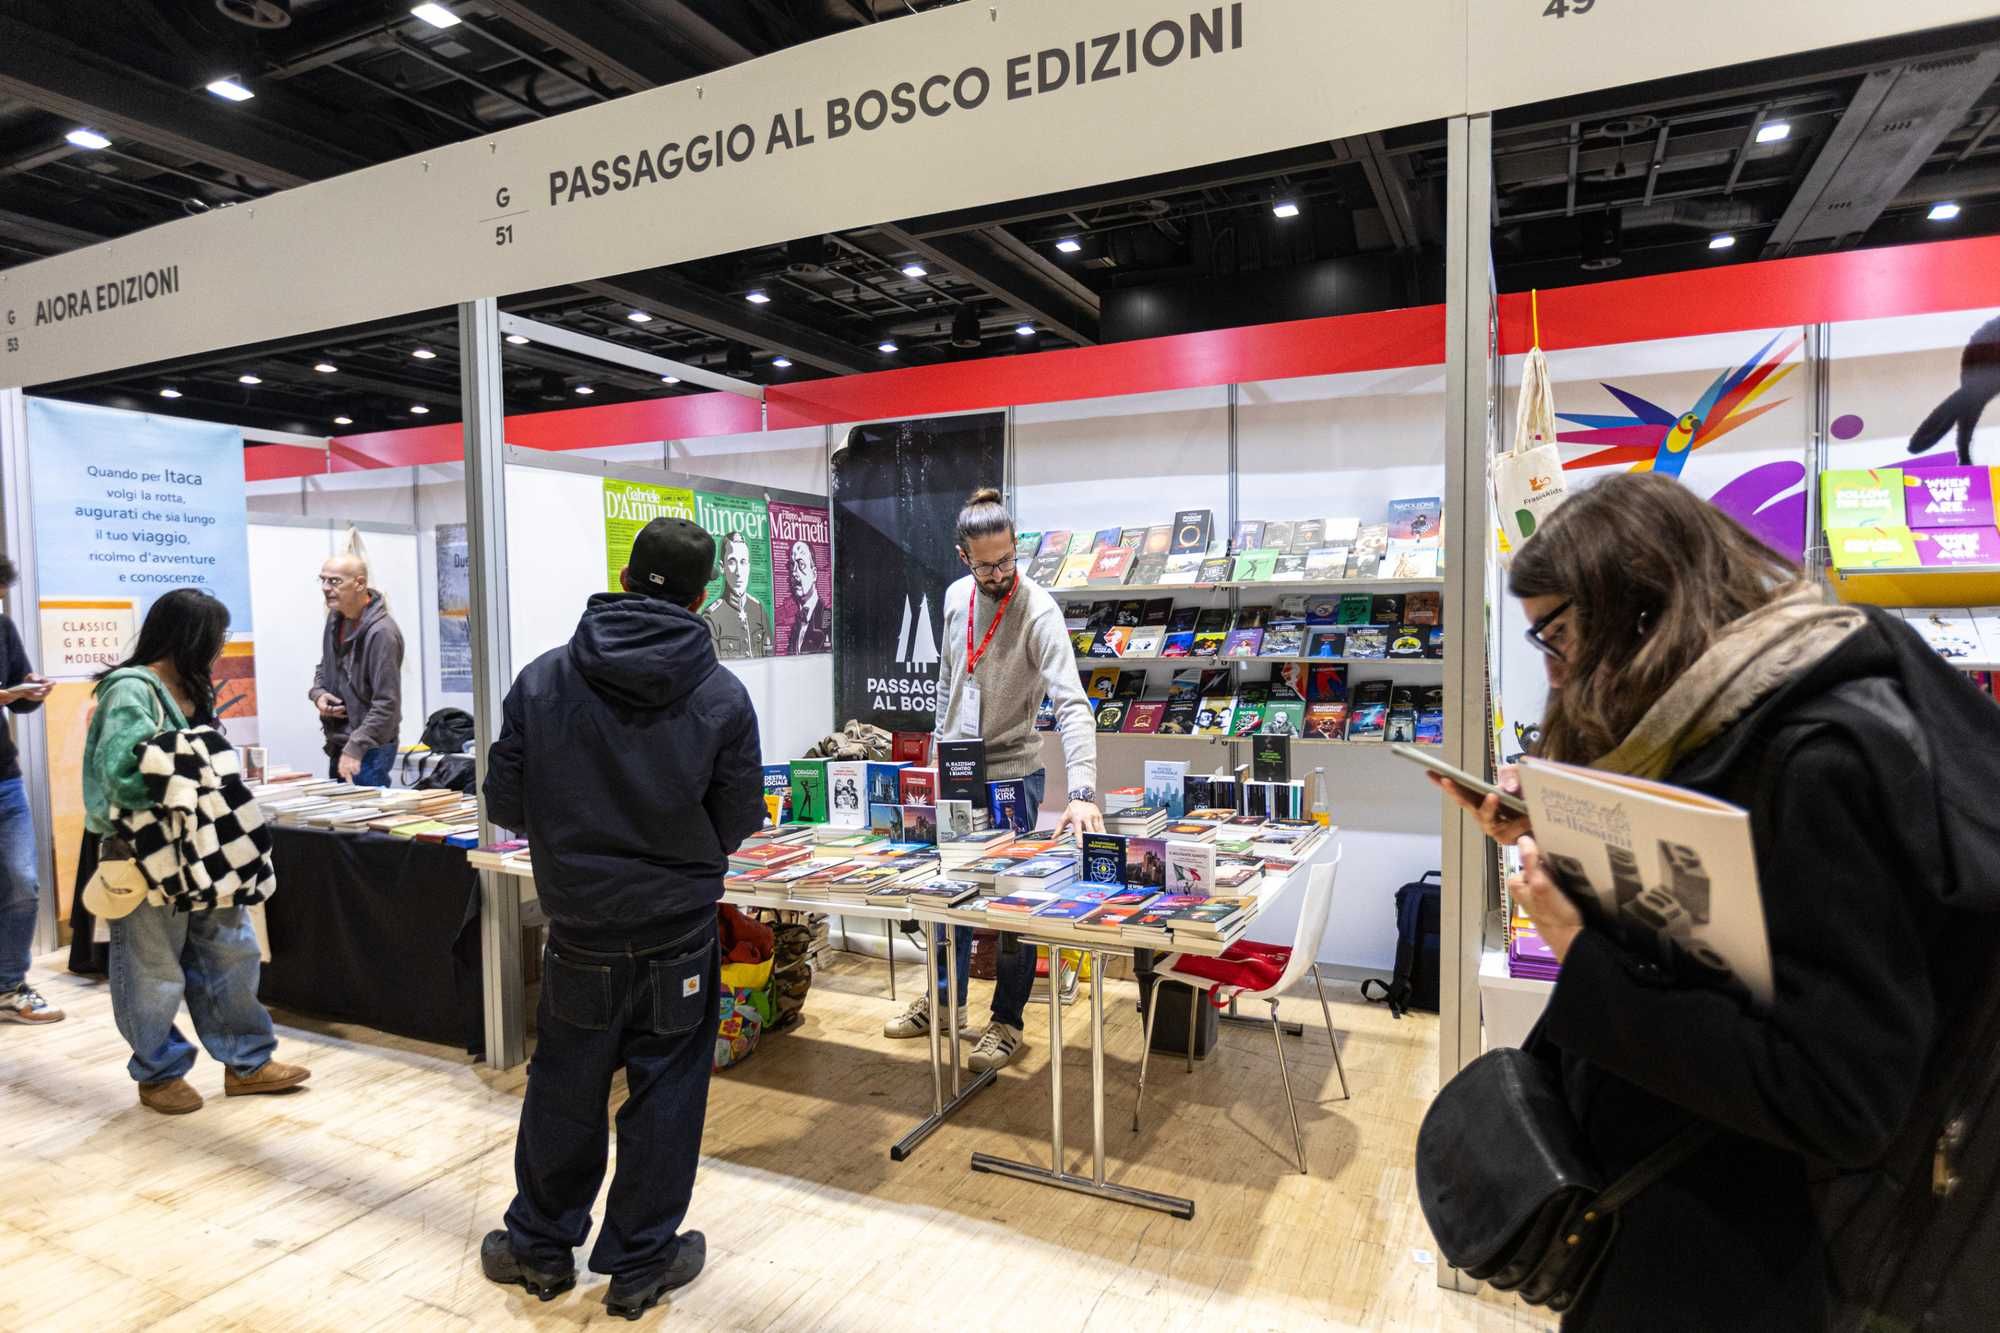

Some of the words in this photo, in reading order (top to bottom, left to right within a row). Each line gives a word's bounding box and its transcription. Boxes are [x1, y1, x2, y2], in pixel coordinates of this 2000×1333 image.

[550, 124, 755, 206] PASSAGGIO
[766, 108, 815, 154] AL
[827, 67, 990, 139] BOSCO
[1006, 2, 1242, 100] EDIZIONI
[496, 187, 510, 207] G
[495, 225, 513, 245] 51
[35, 290, 92, 326] AIORA
[96, 265, 180, 312] EDIZIONI
[7, 310, 16, 325] G
[7, 337, 19, 352] 53
[87, 466, 138, 480] Quando
[141, 472, 160, 482] per
[165, 469, 203, 485] Itaca
[1925, 477, 1971, 488] WHEN
[106, 488, 137, 501] volgi
[141, 490, 151, 500] la
[155, 492, 186, 504] rotta,
[626, 486, 660, 504] Gabriele
[1929, 487, 1969, 501] WE
[605, 490, 693, 522] D'Annunzio
[75, 506, 138, 520] augurati
[142, 511, 162, 521] che
[165, 512, 180, 522] sia
[184, 513, 216, 527] lungo
[696, 496, 768, 540] Jünger
[769, 511, 829, 543] Marinetti
[96, 530, 102, 540] il
[106, 531, 128, 541] tuo
[89, 552, 135, 563] ricolmo
[139, 552, 216, 565] d'avventure
[63, 621, 118, 632] CLASSICI
[65, 653, 119, 664] MODERNI
[873, 695, 897, 710] AL
[995, 791, 1016, 801] KIRK
